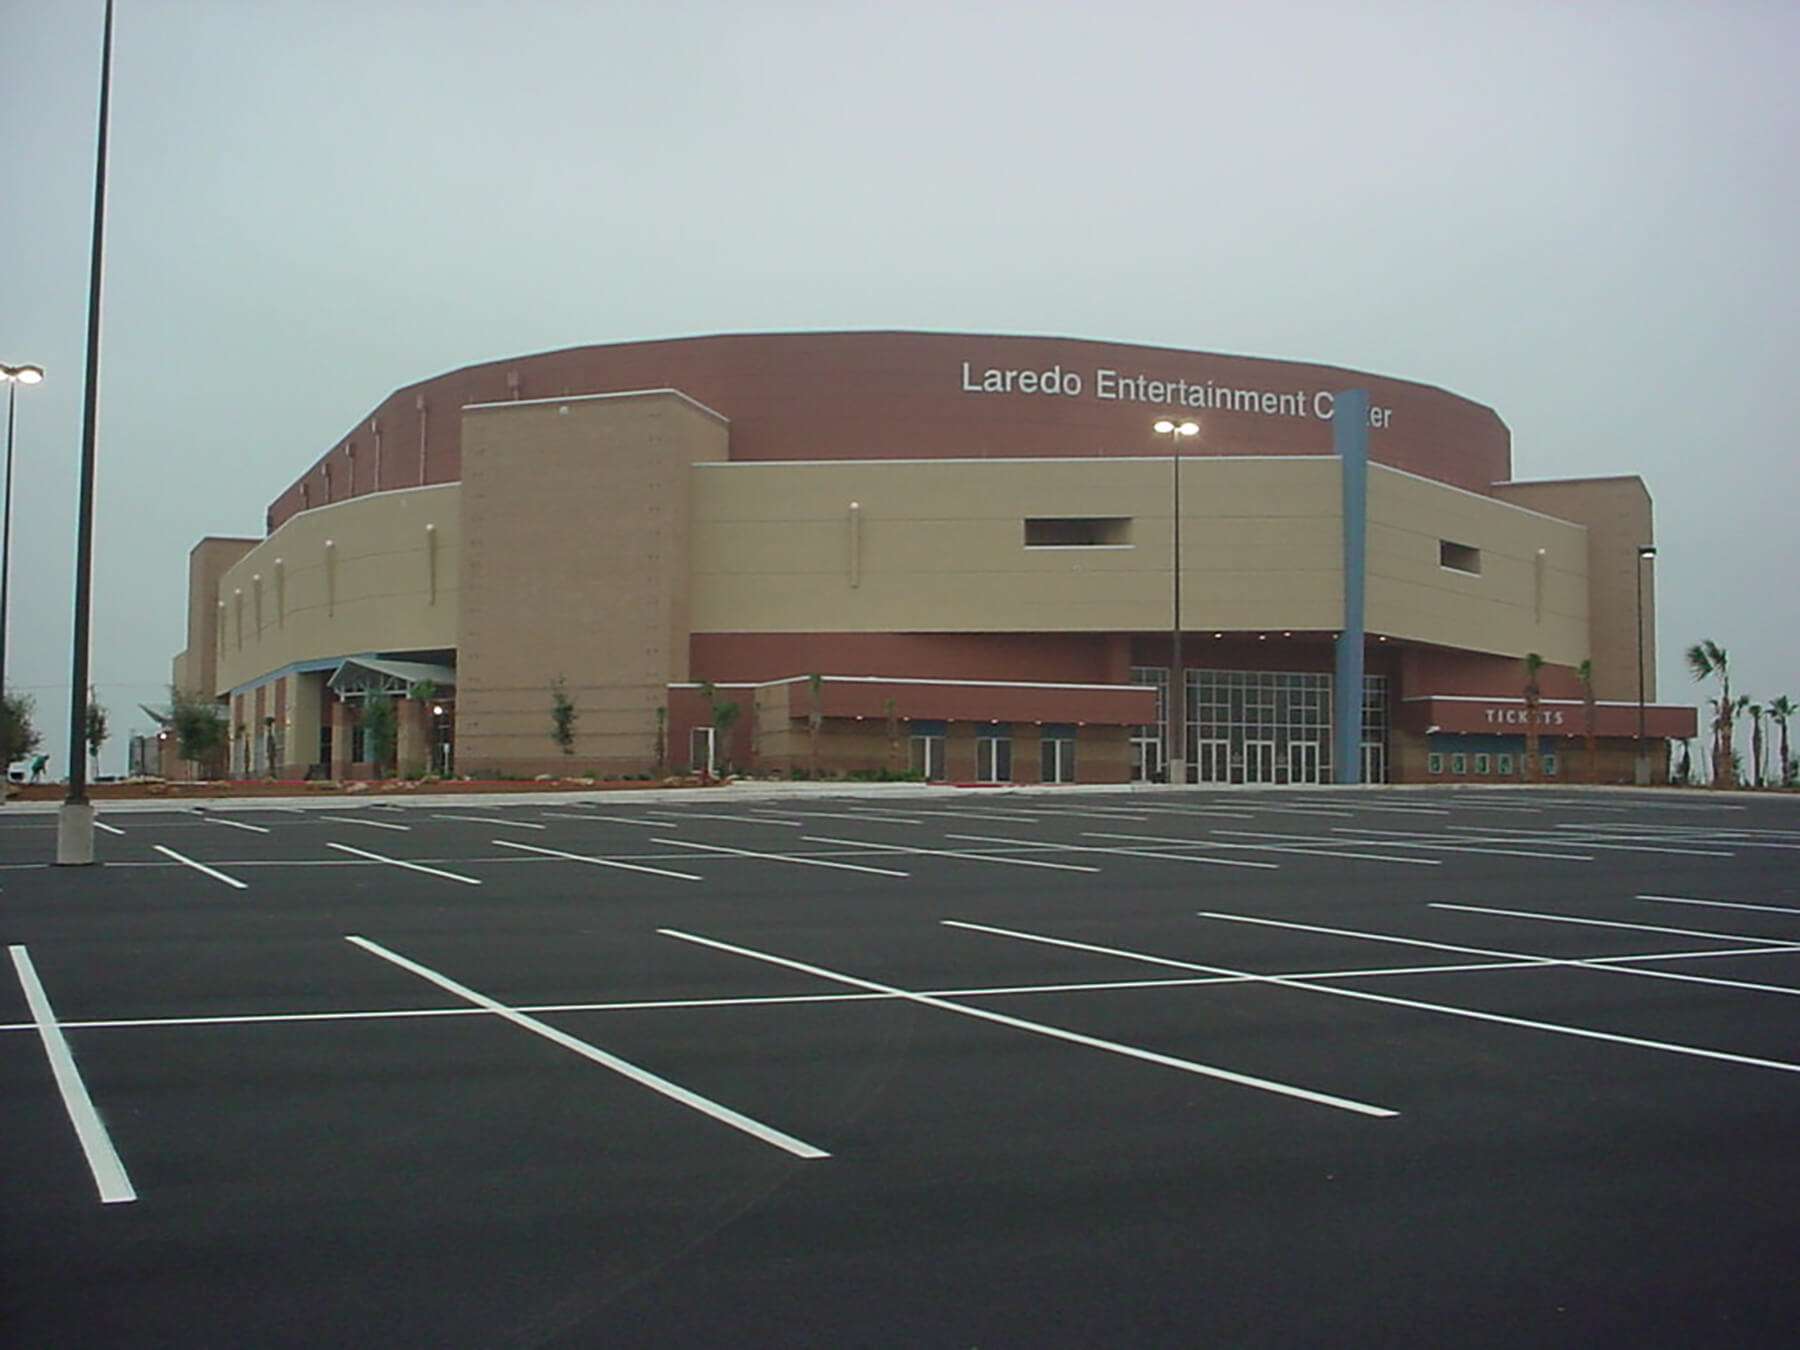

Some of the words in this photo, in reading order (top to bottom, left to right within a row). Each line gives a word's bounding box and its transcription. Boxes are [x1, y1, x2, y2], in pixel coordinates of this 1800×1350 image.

[962, 362, 1082, 396] Laredo
[1096, 369, 1307, 417] Entertainment
[1313, 391, 1392, 428] Cer
[1485, 709, 1564, 725] TICKTS
